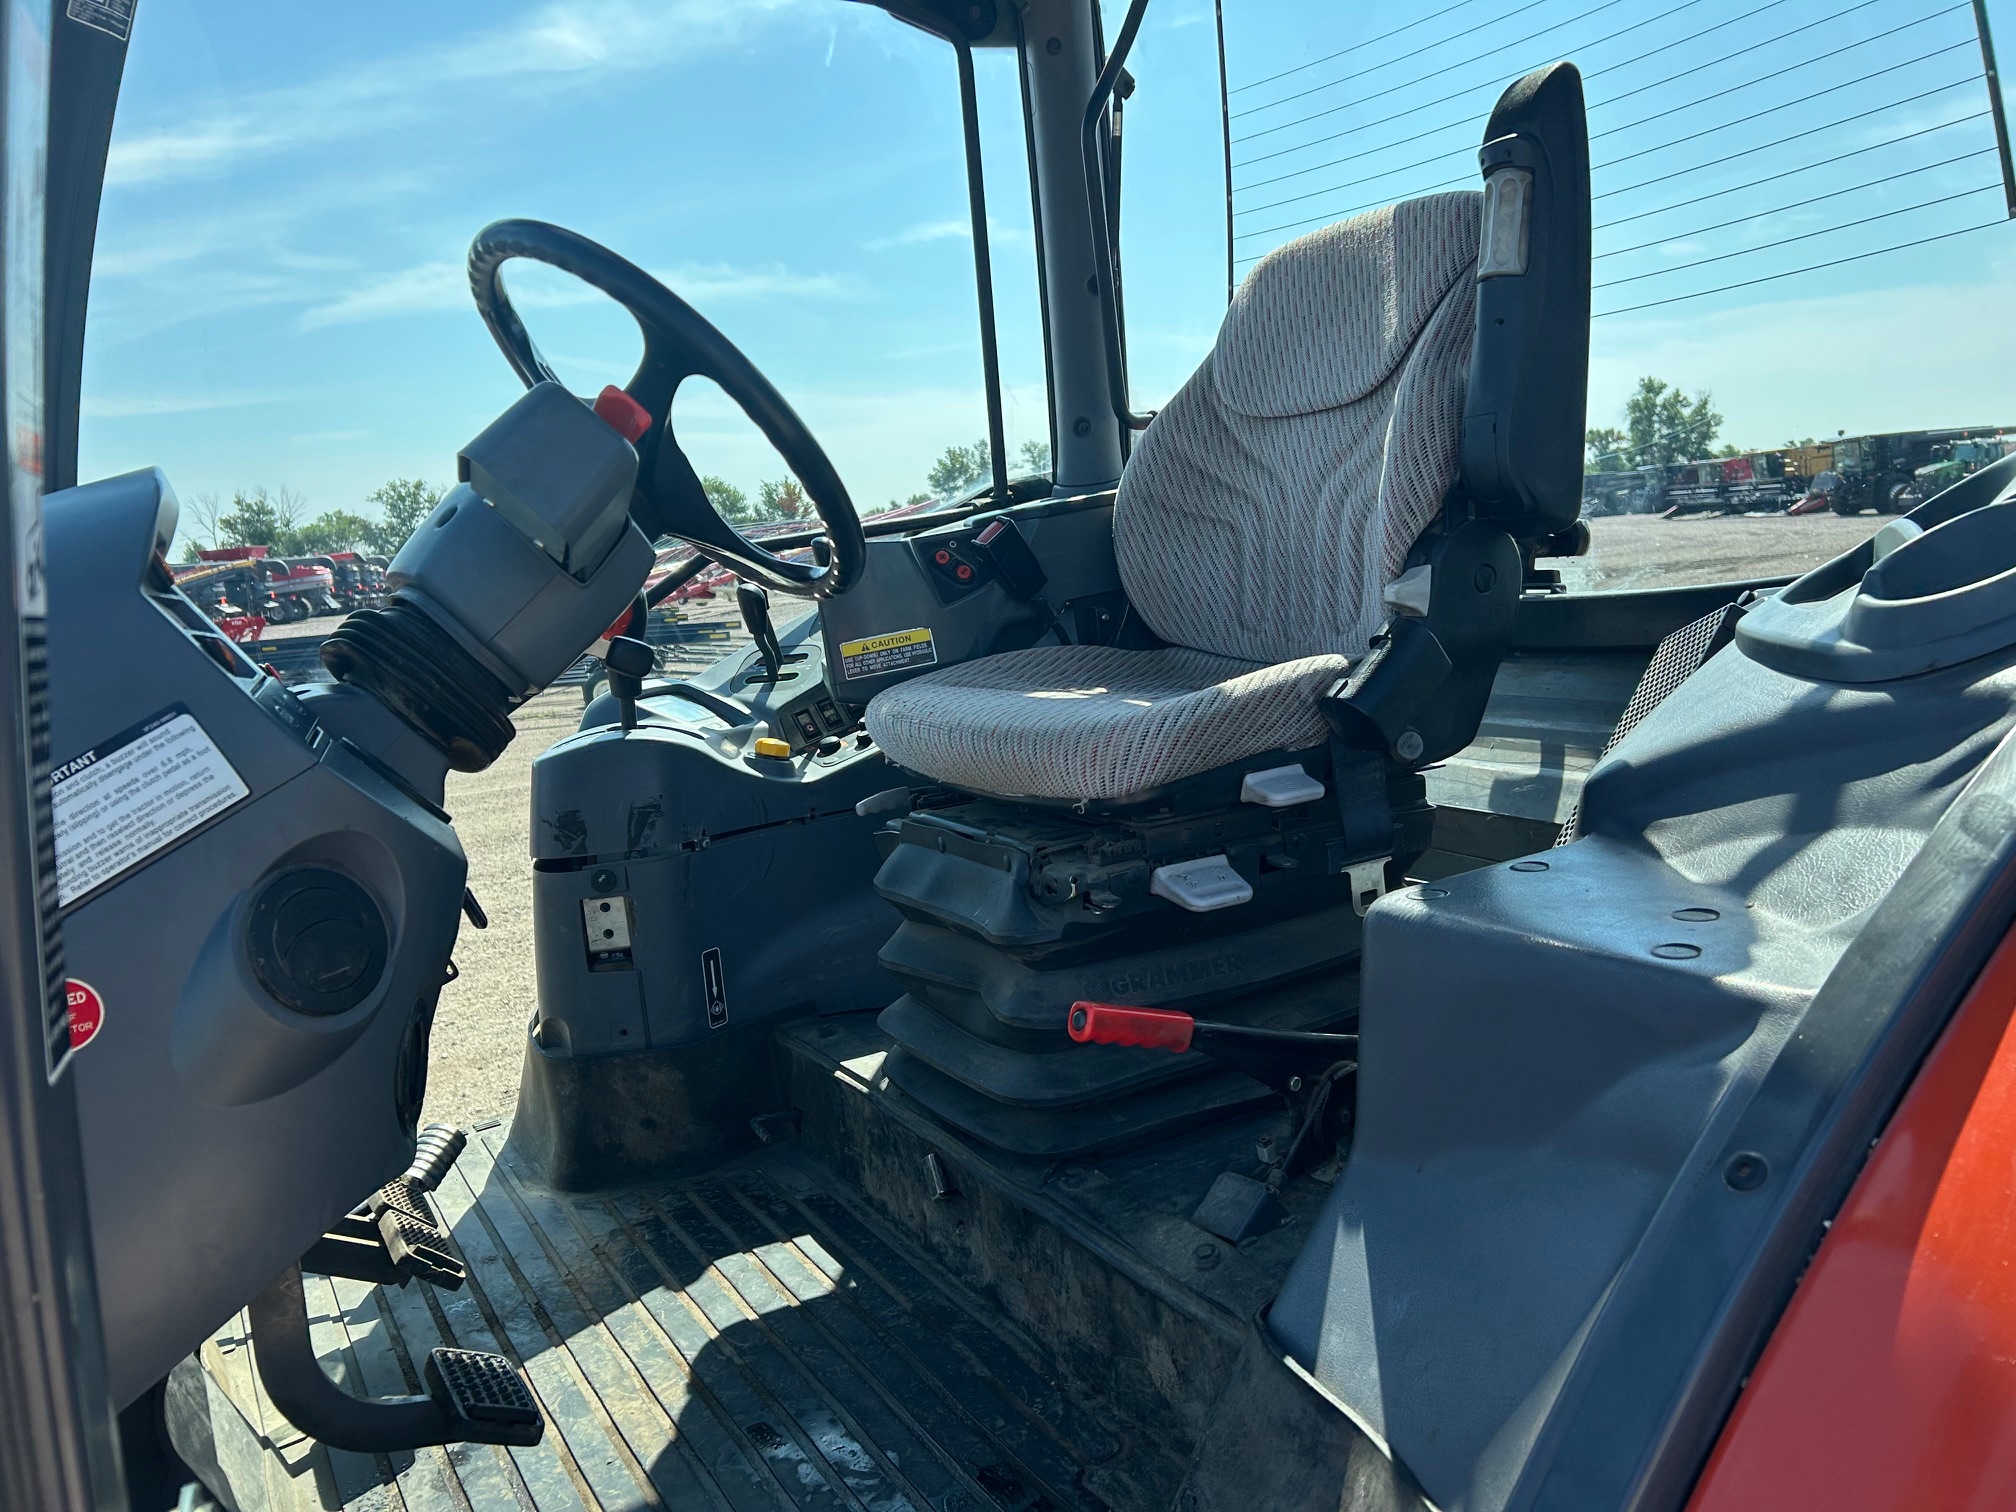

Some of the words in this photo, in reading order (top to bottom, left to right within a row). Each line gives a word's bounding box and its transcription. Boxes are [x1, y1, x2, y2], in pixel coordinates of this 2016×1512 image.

[855, 651, 878, 661] (UP-DOWN)
[863, 657, 876, 665] OTHER
[912, 646, 932, 655] HYDRAULIC
[872, 635, 911, 648] CAUTION
[847, 666, 860, 674] LEVER
[870, 662, 881, 670] MOVE
[50, 750, 98, 784] RTANT
[65, 779, 81, 791] and
[110, 749, 135, 765] buzzer
[135, 740, 148, 751] will
[148, 727, 171, 744] sound
[97, 761, 132, 783] disengage
[134, 749, 153, 762] under
[152, 742, 165, 751] the
[165, 725, 196, 744] following
[68, 809, 100, 833] (slipping)
[110, 794, 130, 808] using
[128, 787, 141, 797] the
[142, 774, 161, 789] clutch
[162, 762, 181, 779] pedal
[181, 758, 190, 766] as
[196, 745, 211, 757] foot
[68, 800, 100, 820] direction
[103, 792, 111, 801] at
[114, 777, 140, 795] speeds
[142, 767, 158, 778] over
[83, 831, 97, 844] and
[106, 819, 119, 832] get
[118, 813, 131, 823] the
[131, 799, 155, 815] tractor
[189, 766, 211, 781] return
[58, 856, 74, 870] utral
[75, 847, 89, 859] and
[88, 839, 106, 851] then
[107, 819, 136, 841] reselect
[135, 803, 166, 824] direction
[166, 798, 175, 806] or
[174, 782, 202, 801] depress
[202, 774, 215, 784] the
[58, 870, 88, 891] ounding
[87, 855, 113, 873] buzzer
[113, 842, 135, 858] warns
[135, 836, 143, 845] of
[143, 810, 189, 840] inappropriate
[188, 785, 232, 813] transmission
[70, 878, 91, 893] Refer
[91, 873, 100, 881] to
[101, 851, 136, 875] operator's
[137, 834, 162, 854] manual
[162, 829, 173, 838] for
[174, 813, 198, 832] correct
[78, 855, 92, 868] and
[96, 840, 121, 858] release
[1109, 955, 1242, 996] GRAMMER
[66, 991, 87, 1006] ED
[70, 1021, 94, 1033] TOR
